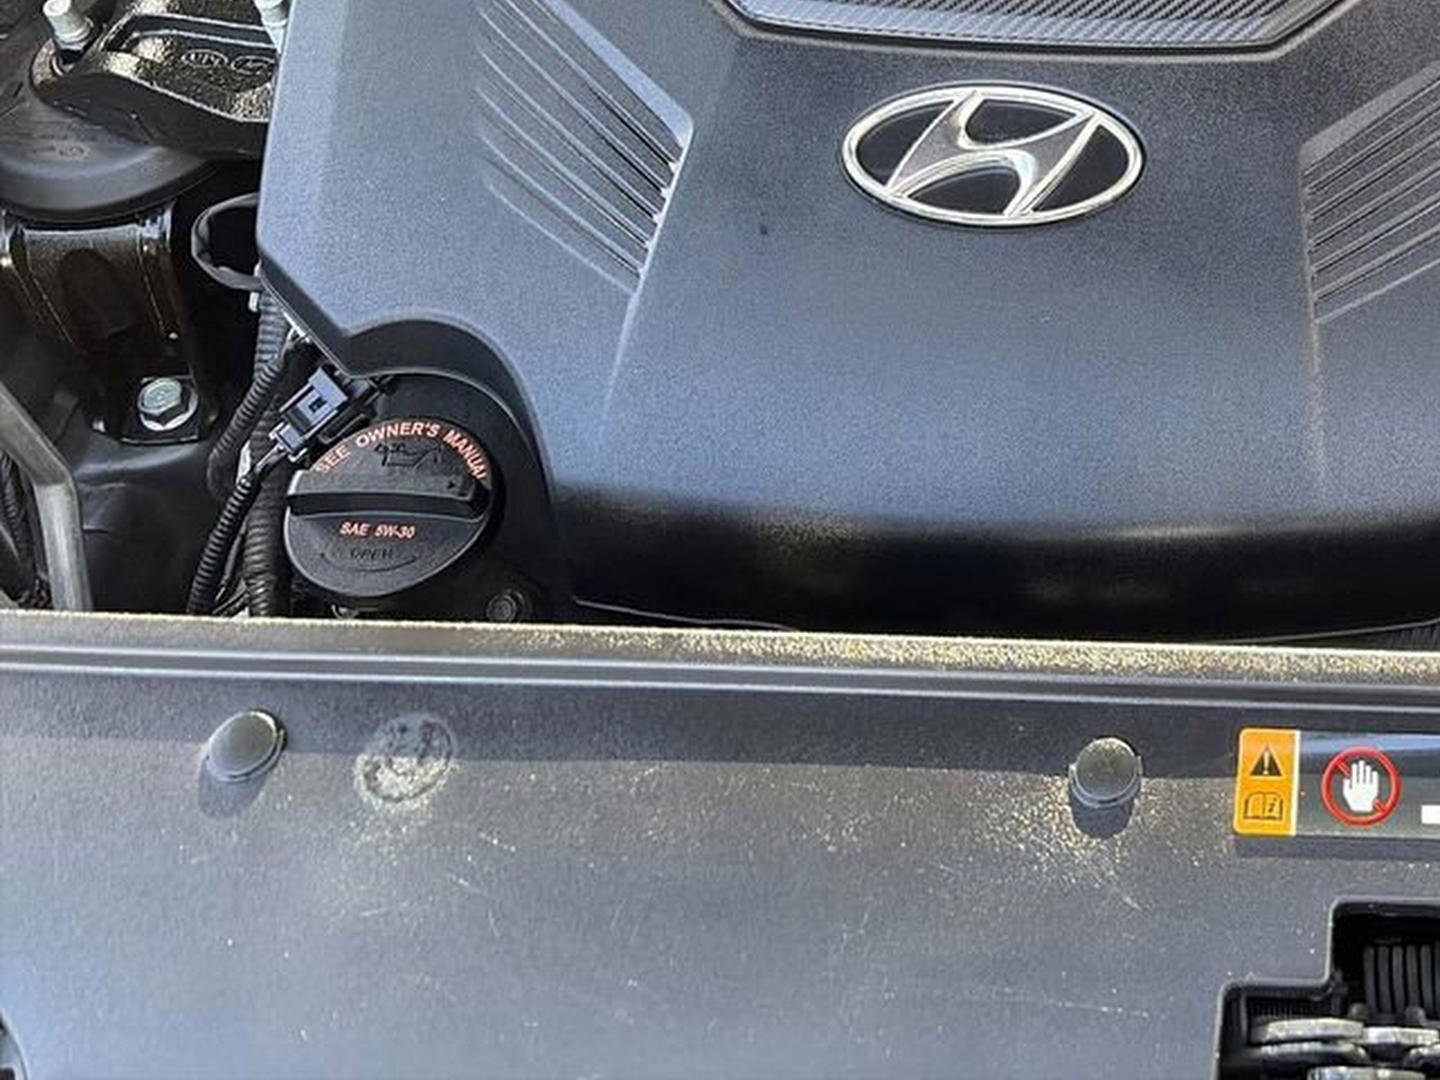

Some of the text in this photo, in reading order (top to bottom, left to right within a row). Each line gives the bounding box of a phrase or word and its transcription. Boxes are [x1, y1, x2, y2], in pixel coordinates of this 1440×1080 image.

[314, 443, 351, 472] SEE
[355, 421, 441, 448] OWNER'S
[339, 521, 416, 539] SAE 5W-30
